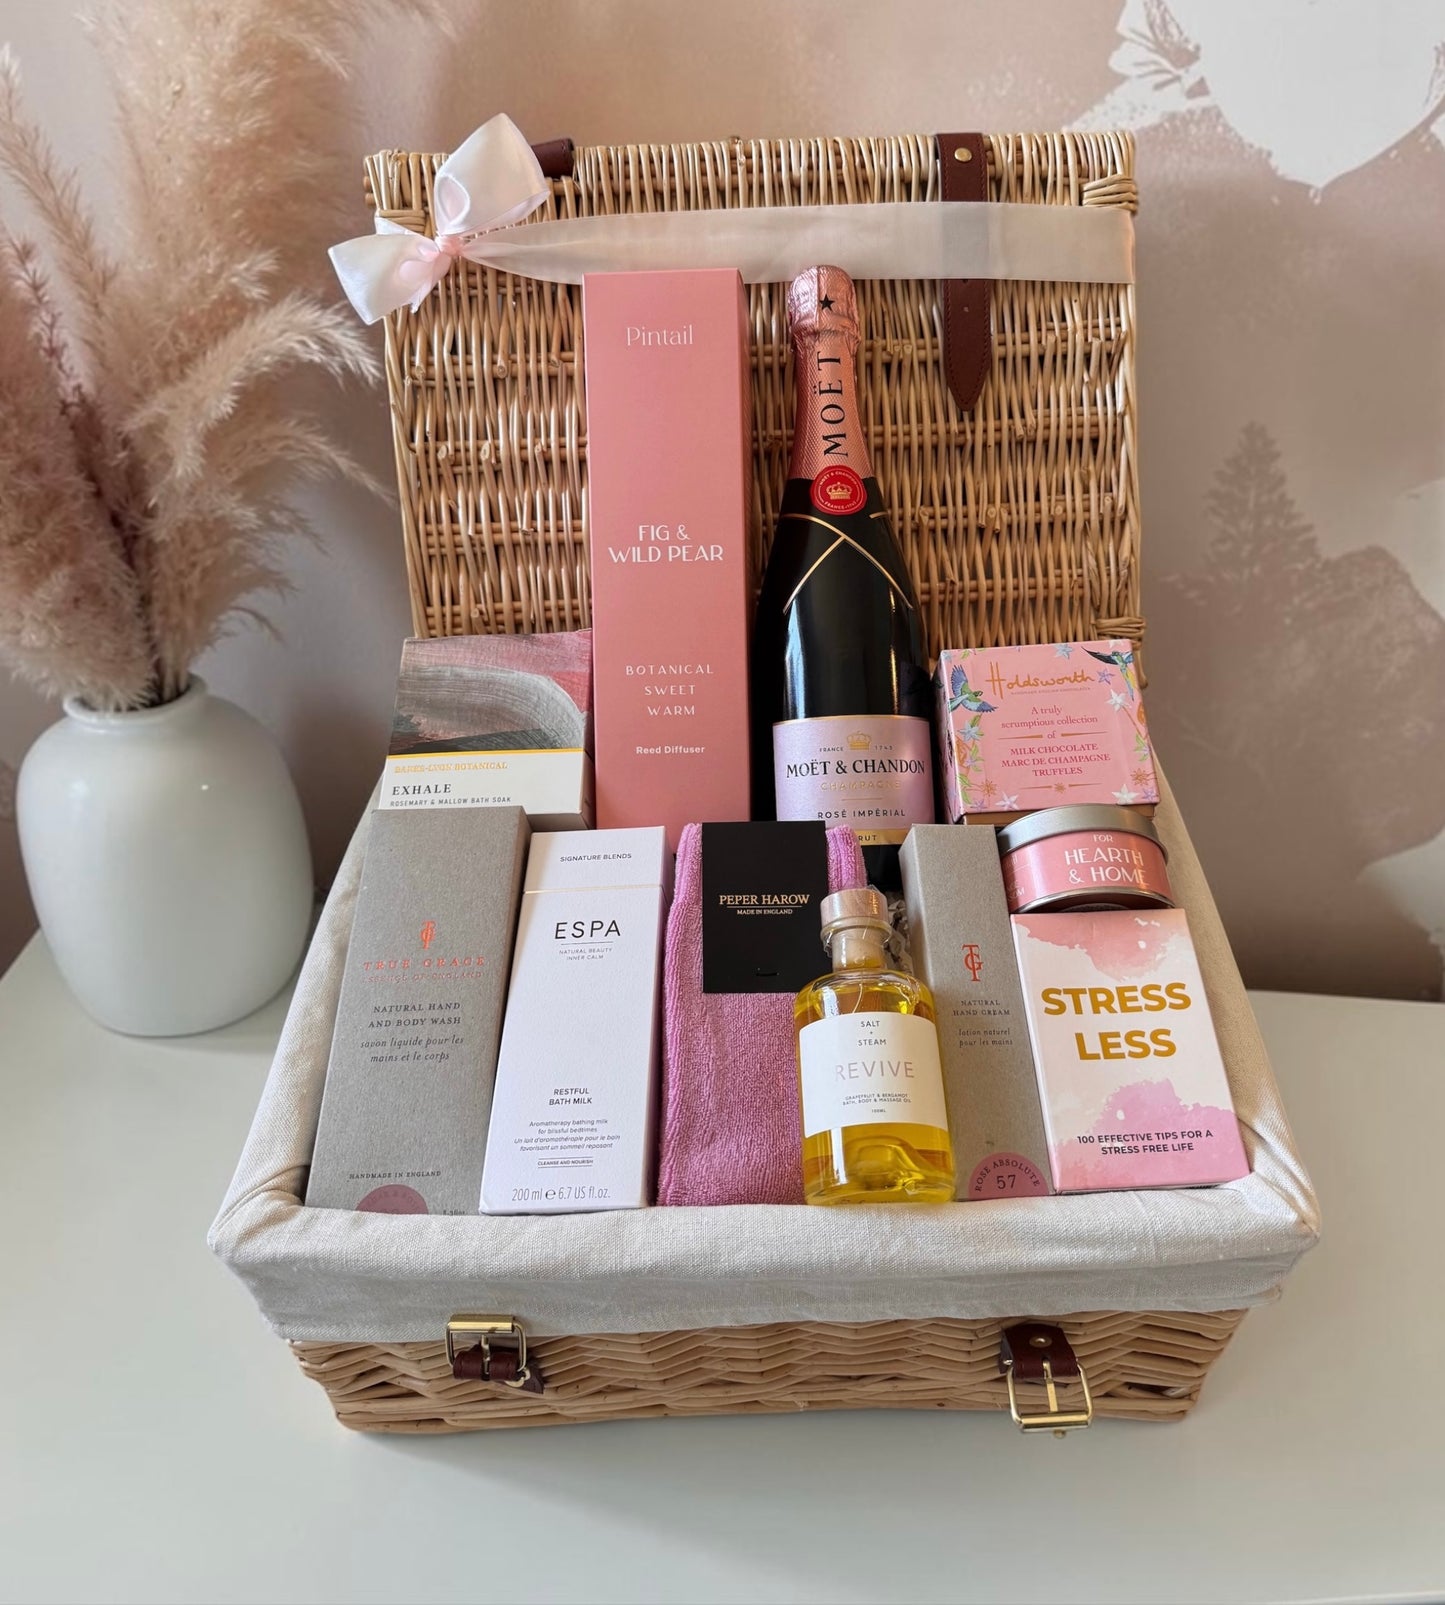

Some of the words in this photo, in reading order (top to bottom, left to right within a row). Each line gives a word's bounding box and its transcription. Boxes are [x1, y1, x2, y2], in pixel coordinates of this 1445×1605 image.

[626, 324, 693, 346] Pintail
[813, 350, 848, 457] MOËT
[638, 524, 670, 541] FIG
[676, 524, 690, 541] &
[608, 546, 662, 563] WILD
[668, 544, 724, 562] PEAR
[626, 664, 713, 675] BOTANICAL
[986, 662, 1095, 699] Holdsworth
[645, 685, 696, 695] SWEET
[648, 706, 695, 715] WARM
[1031, 706, 1039, 714] A
[1041, 705, 1062, 716] truly
[1001, 717, 1054, 729] scrumptious
[1057, 716, 1097, 726] collection
[1047, 730, 1056, 739] of
[636, 746, 661, 754] Reed
[664, 745, 705, 753] Diffuser
[1010, 746, 1036, 756] MILK
[1038, 743, 1098, 754] CHOCOLATE
[454, 762, 507, 771] BOTANICAL
[1001, 758, 1030, 767] MARC
[1033, 757, 1047, 766] DE
[1049, 753, 1110, 764] CHAMPAGNE
[786, 759, 830, 778] MOËT
[836, 760, 847, 774] &
[852, 760, 925, 774] CHANDON
[1032, 767, 1083, 777] TRUFFLES
[392, 784, 452, 795] EXHALE
[821, 781, 901, 791] CHAMPAGNE
[818, 809, 847, 818] ROSÉ
[853, 808, 905, 817] IMPÉRIAL
[1093, 834, 1113, 843] FOR
[1065, 848, 1144, 867] HEARTH
[1069, 869, 1085, 884] &
[1091, 867, 1150, 887] HOME
[719, 895, 759, 905] PEPER
[761, 894, 810, 905] HAROW
[555, 920, 621, 939] ESPA
[363, 959, 411, 971] TRUE
[423, 956, 486, 968] GRACE
[1041, 982, 1192, 1015] STRESS
[374, 1003, 424, 1013] NATURAL
[428, 1002, 461, 1010] HAND
[368, 1020, 391, 1029] AND
[396, 1018, 426, 1026] BODY
[430, 1017, 461, 1025] WASH
[959, 1028, 980, 1036] lotion
[983, 1028, 1010, 1036] naturel
[361, 1040, 387, 1049] savon
[390, 1036, 423, 1049] liquide
[425, 1038, 449, 1049] pour
[452, 1035, 464, 1044] les
[960, 1040, 977, 1048] pour
[980, 1038, 989, 1046] les
[1074, 1028, 1177, 1060] LESS
[370, 1053, 398, 1063] mains
[401, 1052, 409, 1061] et
[413, 1052, 421, 1061] le
[424, 1053, 450, 1063] corps
[835, 1061, 915, 1081] REVIVE
[554, 1088, 590, 1096] RESTFUL
[573, 1097, 592, 1105] MILK
[1077, 1135, 1095, 1144] 100
[1098, 1133, 1152, 1143] EFFECTIVE
[1154, 1132, 1178, 1141] TIPS
[1181, 1130, 1202, 1139] FOR
[1205, 1129, 1213, 1137] A
[1101, 1146, 1140, 1155] STRESS
[1143, 1144, 1169, 1152] FREE
[1172, 1142, 1194, 1151] LIFE
[349, 1172, 392, 1180] HANDMADE
[975, 1167, 991, 1192] ROSE
[993, 1159, 1040, 1187] ABSOLUTE
[996, 1174, 1016, 1190] 57
[512, 1188, 529, 1201] 200
[532, 1188, 543, 1200] ml
[558, 1187, 572, 1200] 6.7
[574, 1187, 586, 1199] US
